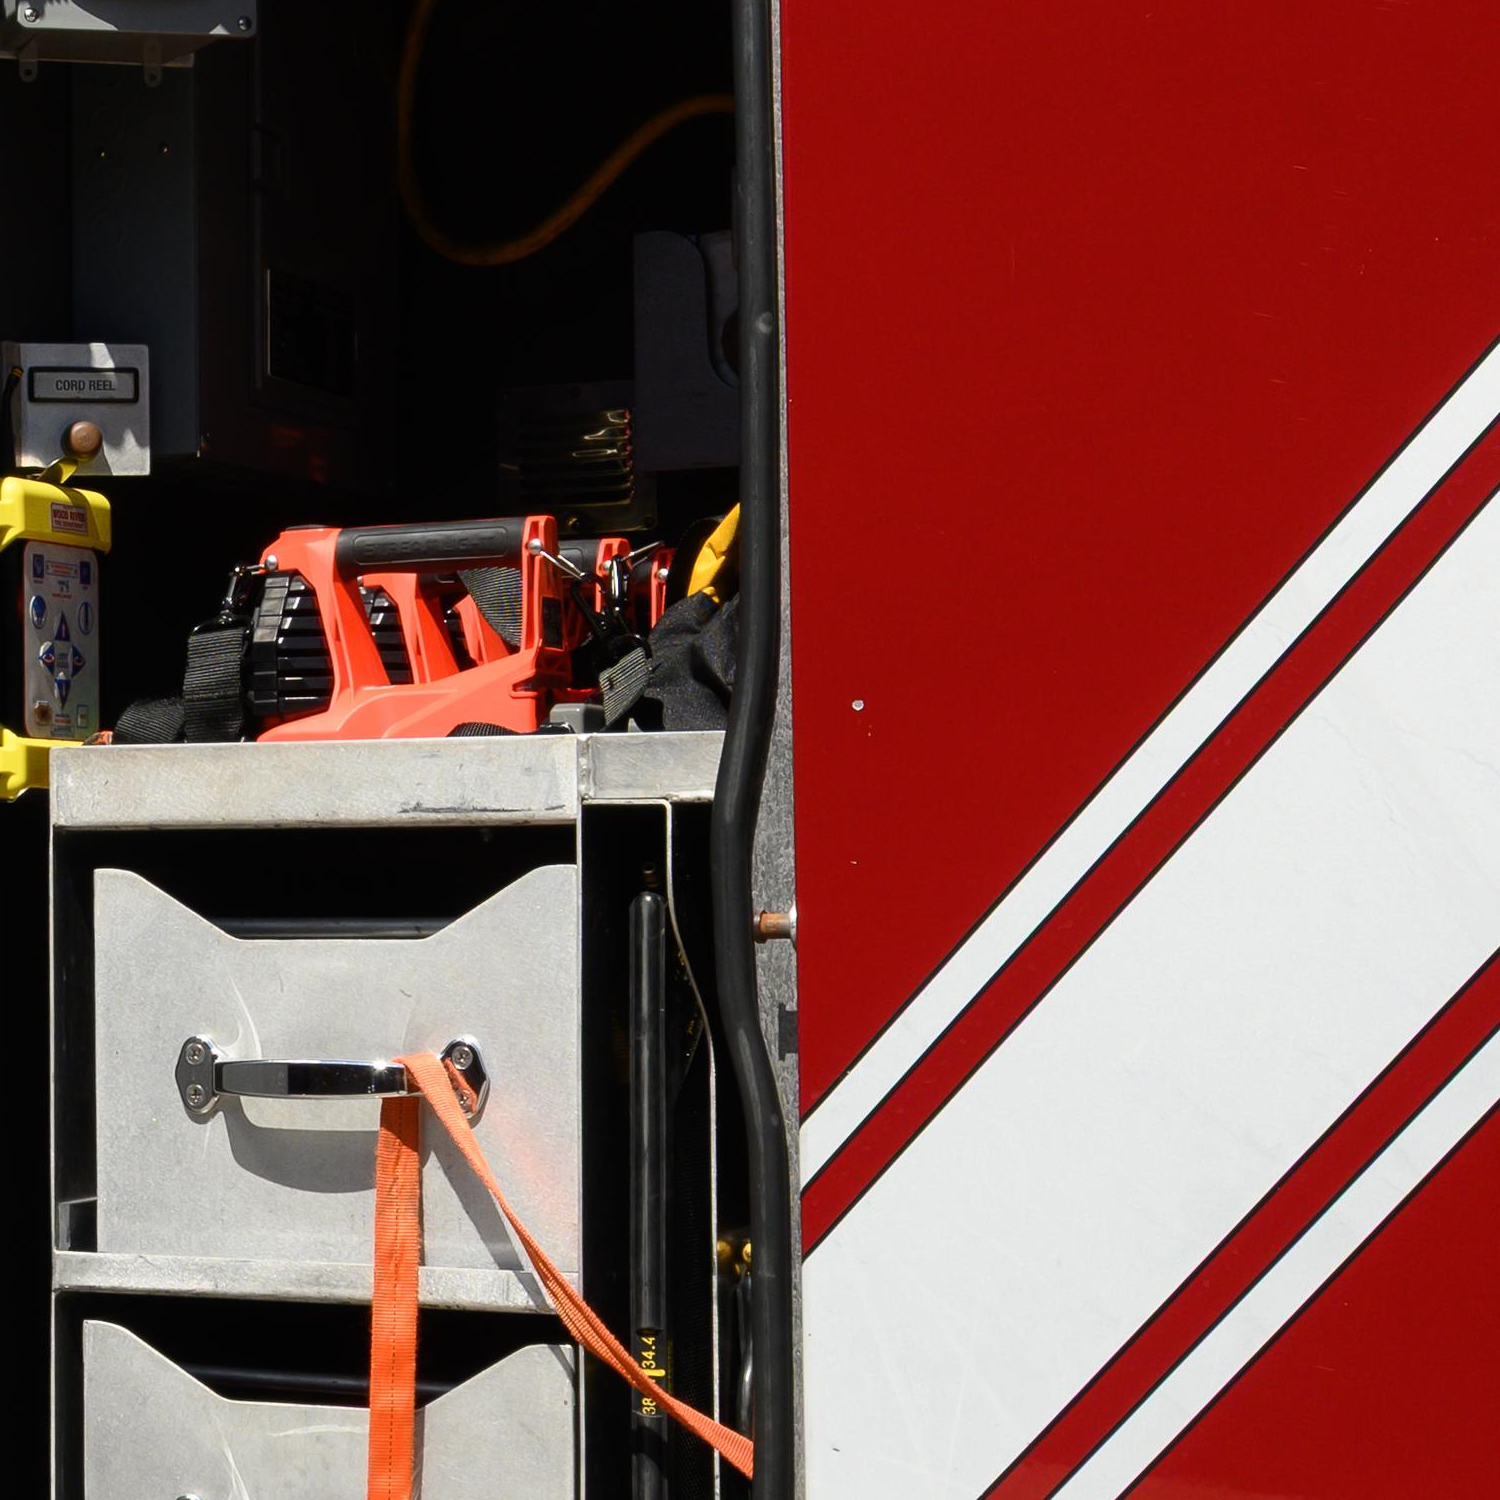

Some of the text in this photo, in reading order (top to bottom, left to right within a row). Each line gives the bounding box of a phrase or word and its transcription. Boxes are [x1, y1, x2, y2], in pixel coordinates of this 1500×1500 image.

[55, 380, 116, 391] CORD REEL
[53, 510, 68, 519] WOOD
[641, 1336, 656, 1369] 34.4
